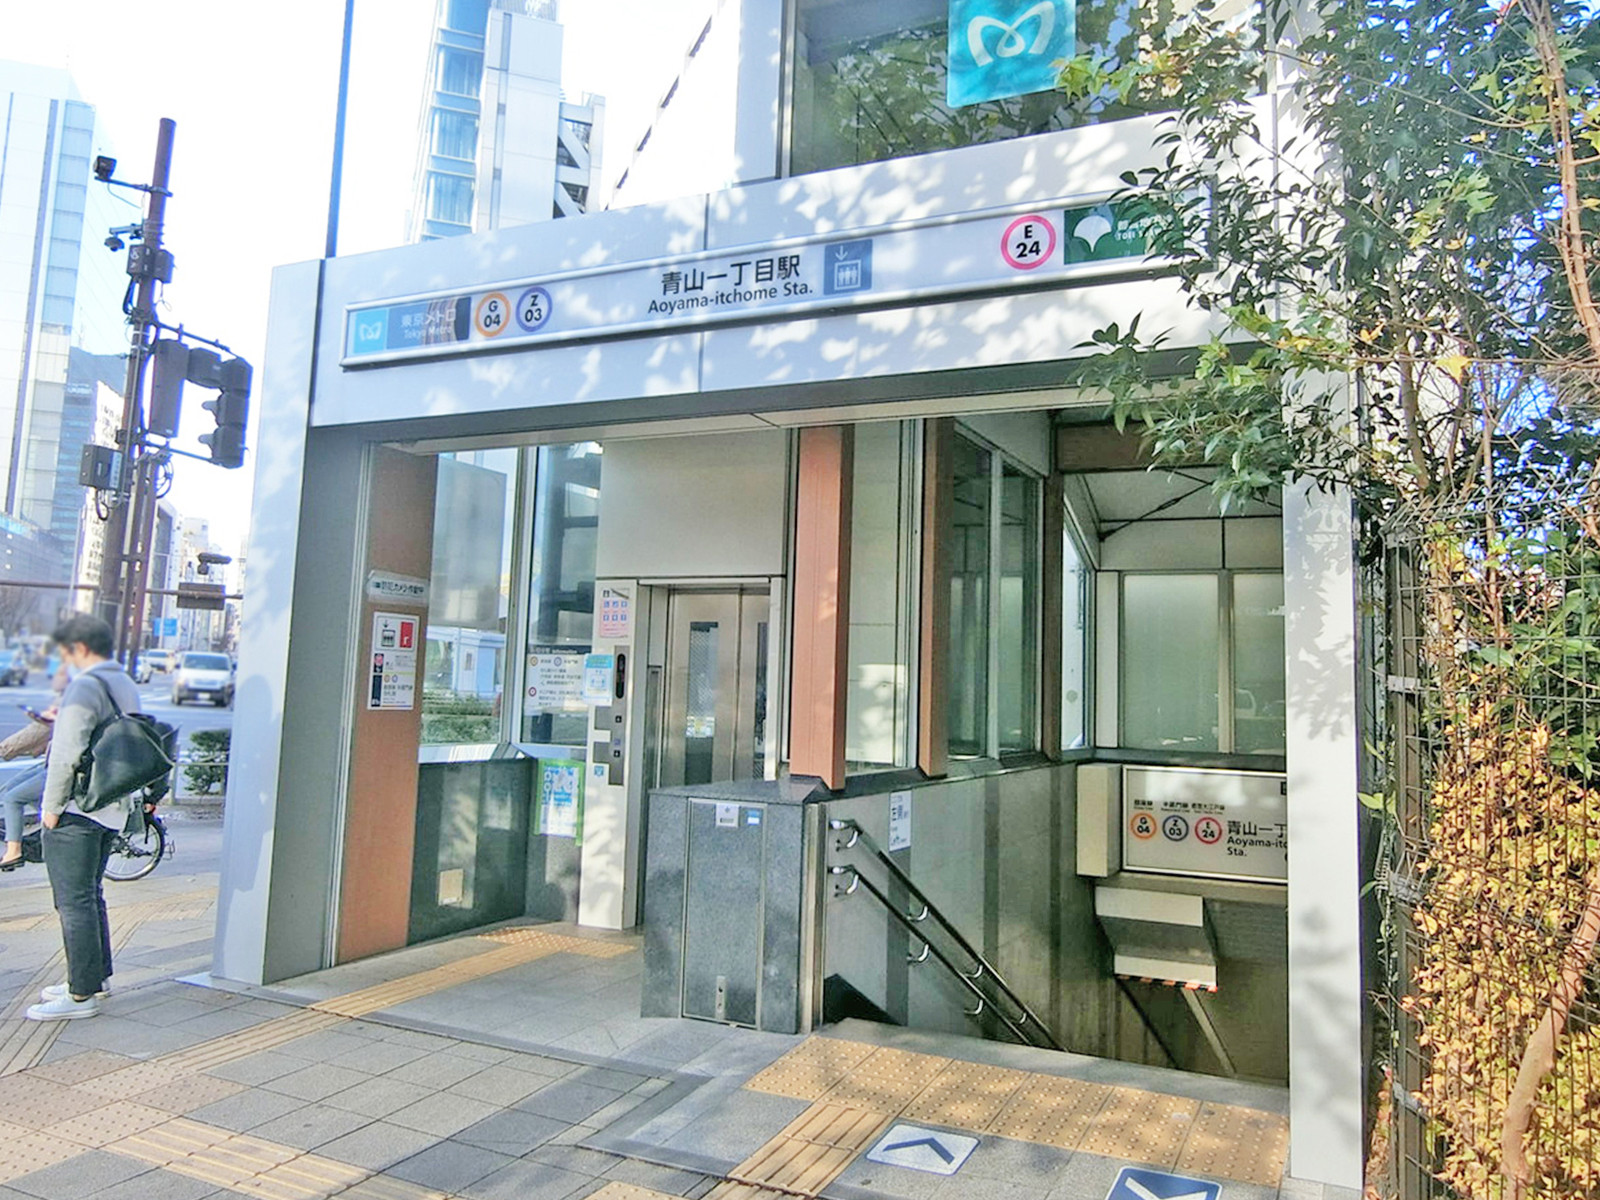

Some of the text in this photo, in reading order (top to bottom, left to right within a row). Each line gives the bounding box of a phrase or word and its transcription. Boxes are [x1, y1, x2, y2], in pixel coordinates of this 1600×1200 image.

[1024, 225, 1033, 239] E
[1016, 241, 1041, 259] 24
[661, 254, 801, 296] 青山一丁目駅
[529, 294, 539, 308] Z
[647, 280, 813, 315] Aoyama-itchome Sta.
[488, 300, 498, 313] G
[401, 308, 457, 328] 東京メトロ
[484, 313, 502, 329] 04
[524, 308, 543, 323] 03
[1136, 824, 1150, 834] 04
[1172, 819, 1179, 827] Z
[1205, 821, 1211, 830] E
[1168, 827, 1182, 837] 03
[1202, 829, 1215, 839] 24
[1227, 847, 1247, 857] Sta.
